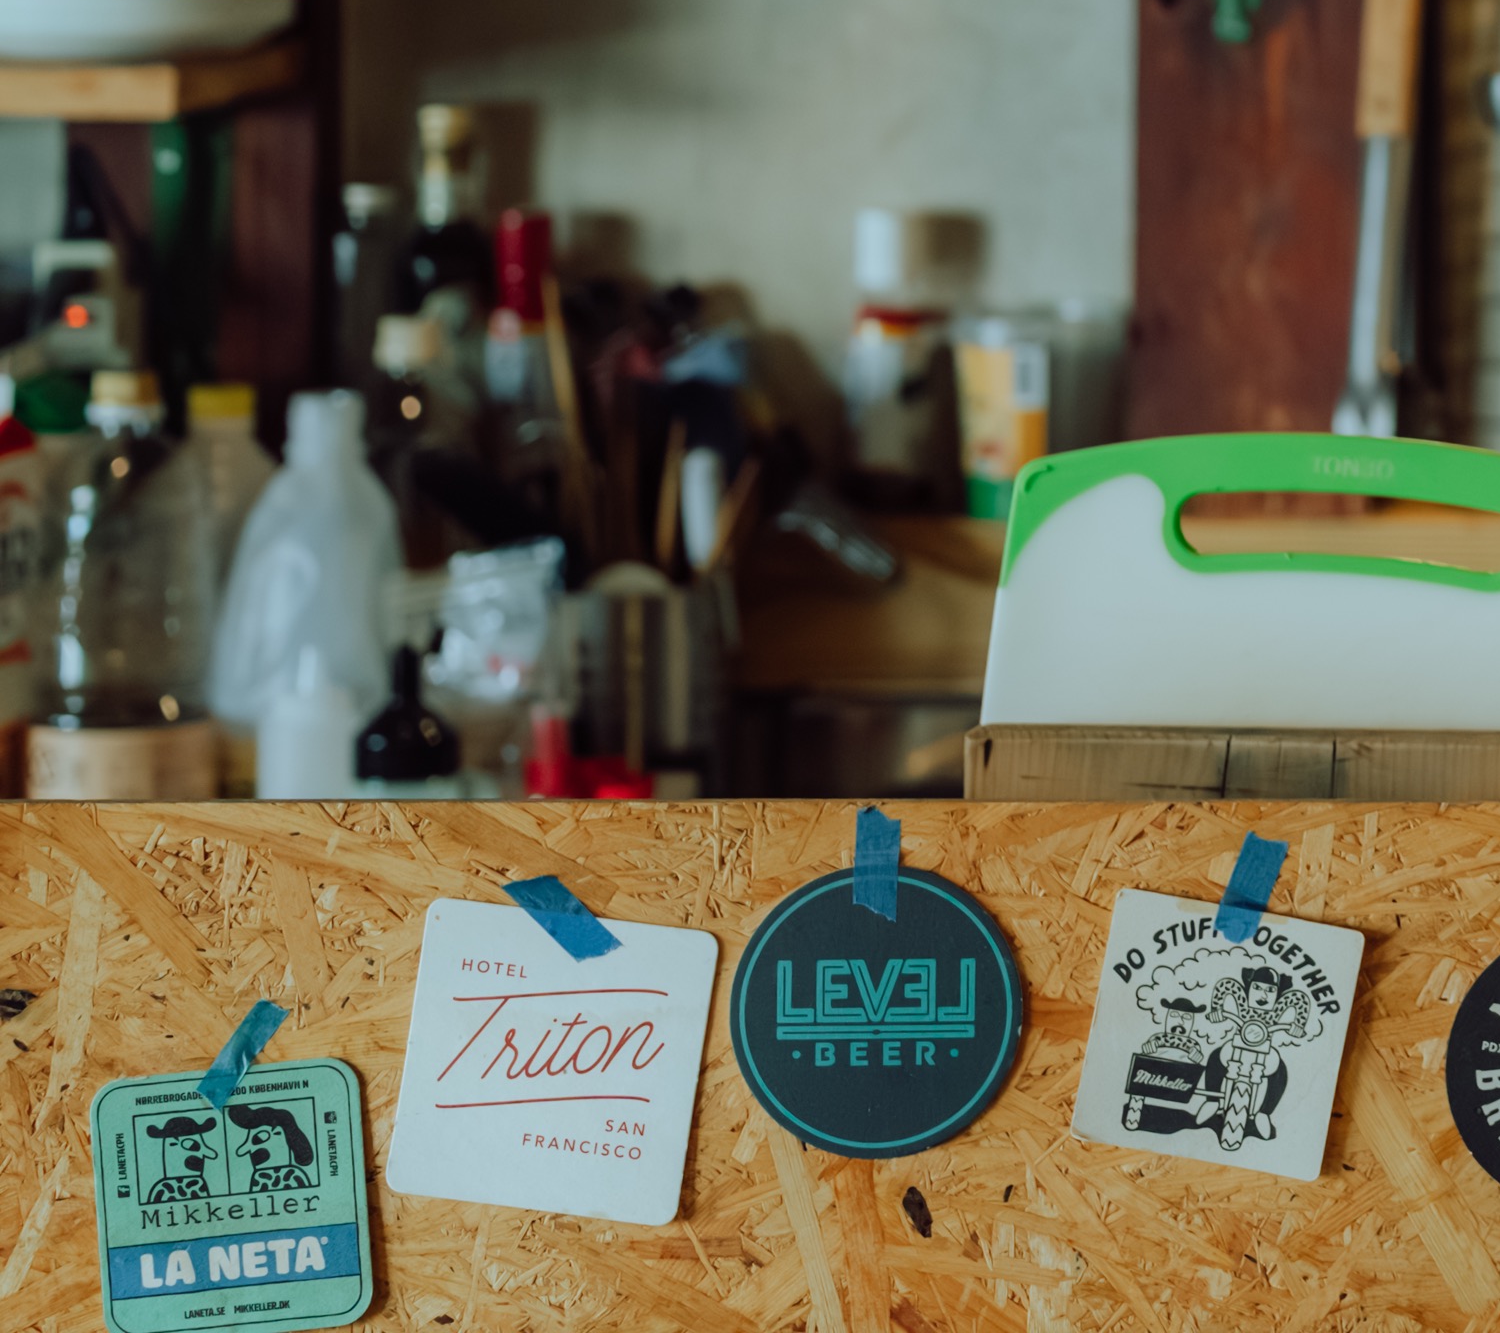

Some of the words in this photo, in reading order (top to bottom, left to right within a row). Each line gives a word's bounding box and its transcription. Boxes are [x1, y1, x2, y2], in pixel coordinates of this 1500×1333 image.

[461, 958, 528, 978] HOTEL
[1113, 948, 1146, 983] DO
[1253, 925, 1341, 1016] OGETHER
[776, 957, 976, 1023] LEVEL
[437, 989, 669, 1082] Triton
[815, 1041, 936, 1066] BEER
[1133, 1069, 1193, 1092] Mikkeller
[605, 1119, 646, 1136] SAN
[522, 1133, 642, 1160] FRANCISCO
[141, 1194, 320, 1230] Mikkeller
[140, 1249, 196, 1289] LA
[208, 1236, 327, 1282] NETA
[184, 1306, 225, 1319] LANETA.SE
[233, 1300, 290, 1313] MIKKELLER.DK
